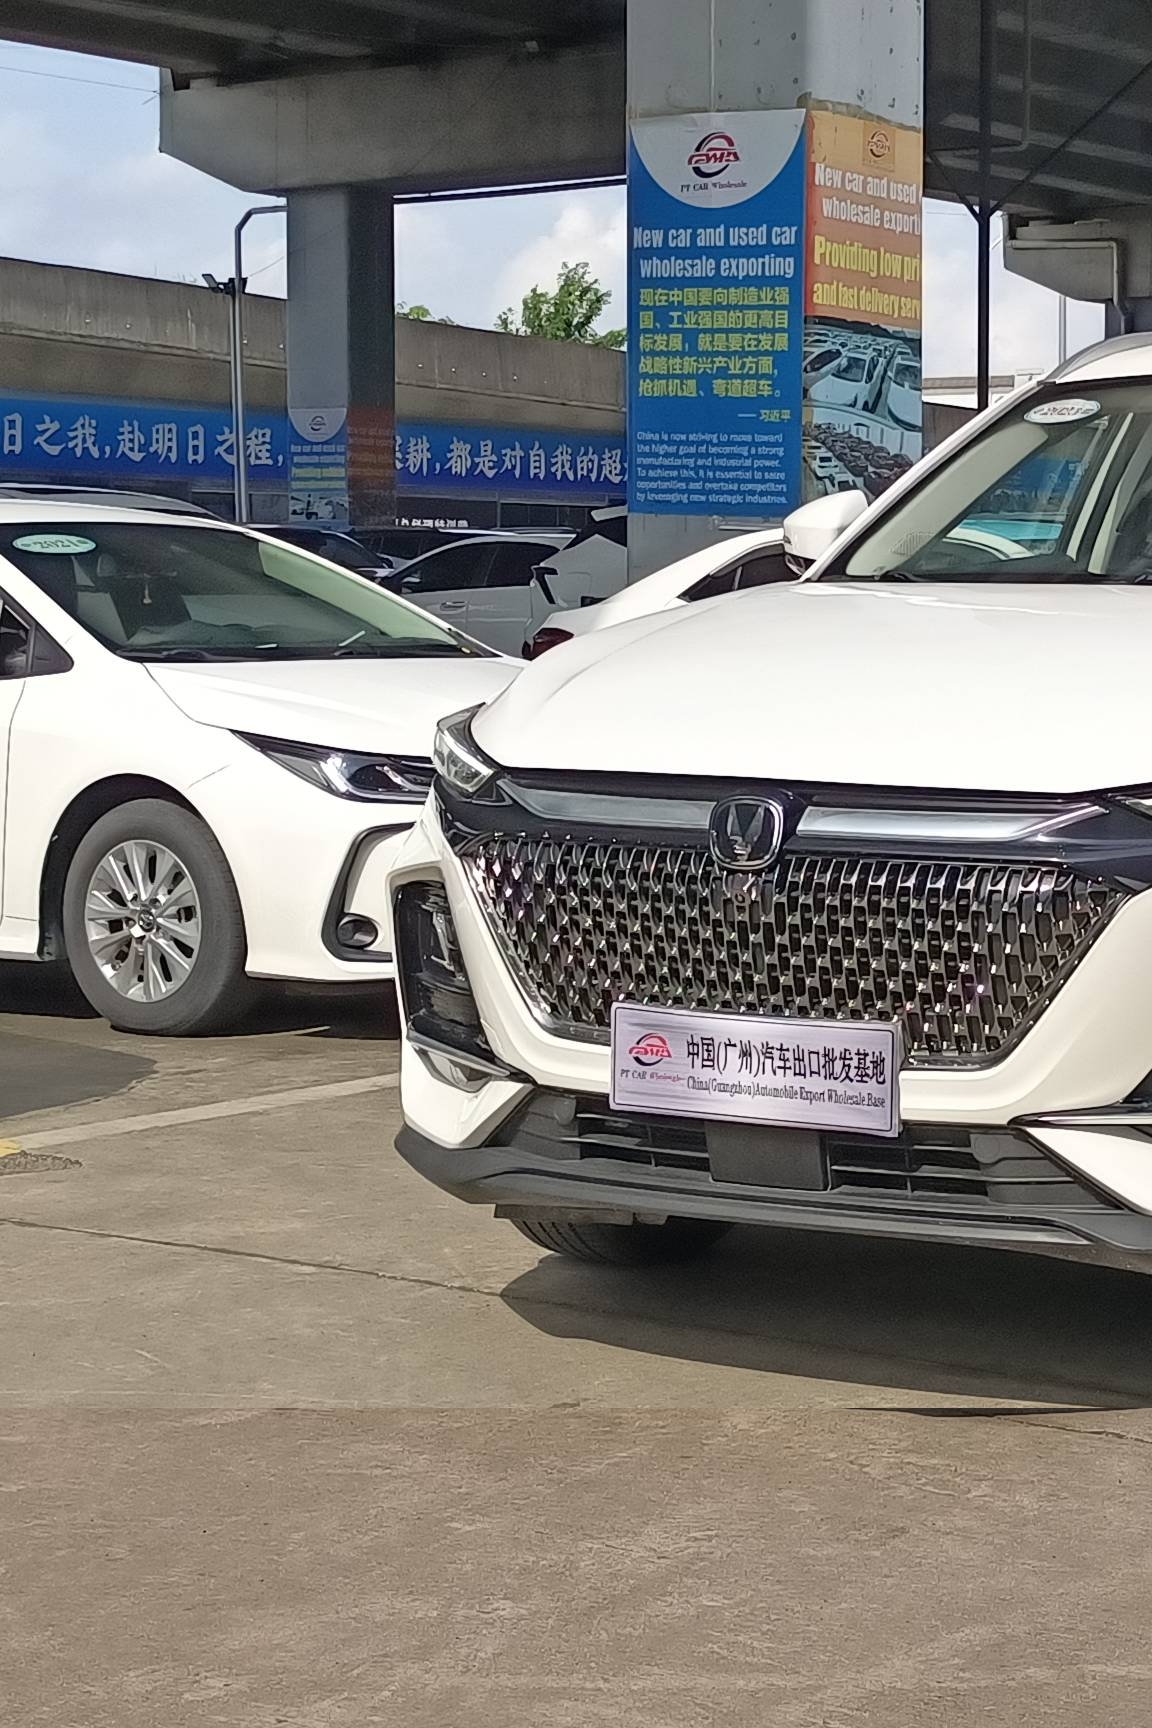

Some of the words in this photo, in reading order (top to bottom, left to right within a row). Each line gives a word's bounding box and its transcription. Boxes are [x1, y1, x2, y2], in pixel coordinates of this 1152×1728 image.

[680, 184, 691, 192] PT
[693, 183, 708, 191] CAR
[814, 162, 842, 188] New
[844, 168, 864, 193] car
[866, 176, 887, 200] and
[889, 181, 916, 205] used
[823, 197, 881, 227] wholesale
[633, 226, 664, 249] New
[668, 227, 692, 248] car
[697, 224, 724, 247] and
[729, 224, 767, 246] used
[771, 224, 798, 246] car
[640, 255, 715, 279] wholesale
[720, 254, 794, 280] exporting
[814, 235, 877, 278] Providing
[880, 247, 902, 279] low
[813, 280, 837, 306] and
[838, 281, 858, 309] fast
[859, 287, 900, 319] delivery
[686, 1034, 886, 1085] 中国(广州)汽车出口批发基地
[620, 1069, 631, 1078] PT
[632, 1069, 647, 1080] CAR
[800, 1086, 825, 1105] Export
[827, 1089, 865, 1106] Wholesale
[867, 1093, 886, 1108] Base
